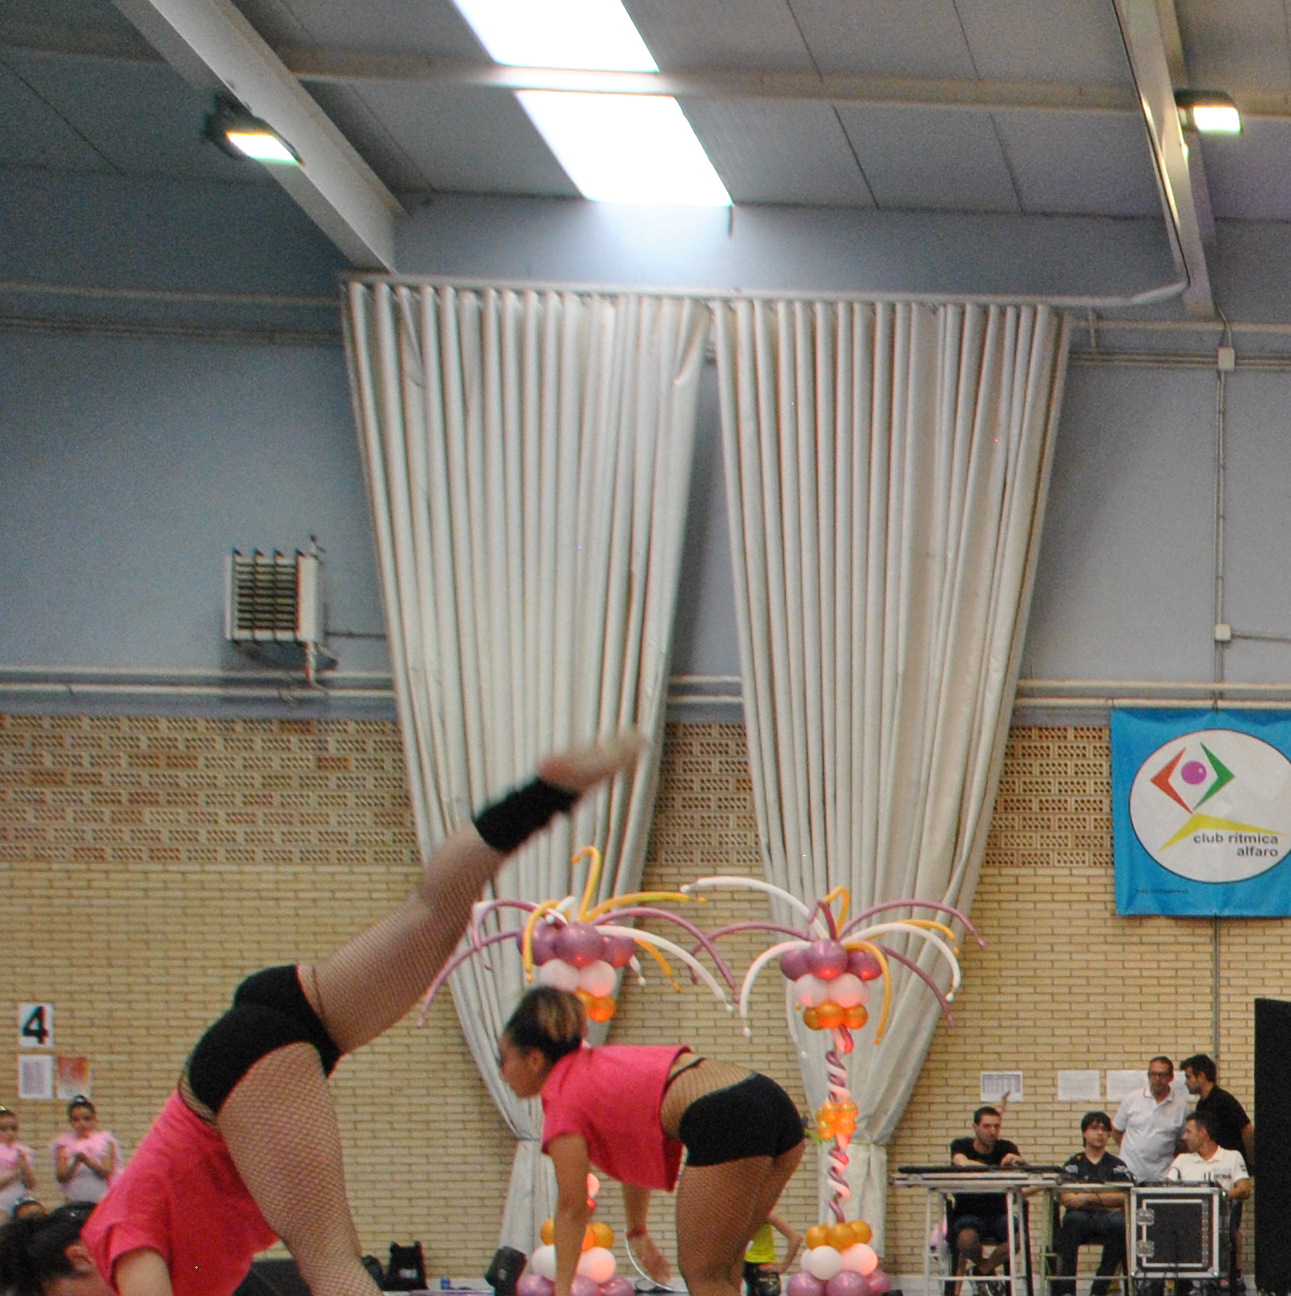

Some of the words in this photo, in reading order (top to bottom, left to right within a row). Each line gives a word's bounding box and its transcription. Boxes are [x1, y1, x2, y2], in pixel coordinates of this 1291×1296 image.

[1194, 832, 1224, 844] club
[1237, 845, 1279, 857] alfaro
[22, 1006, 49, 1045] 4
